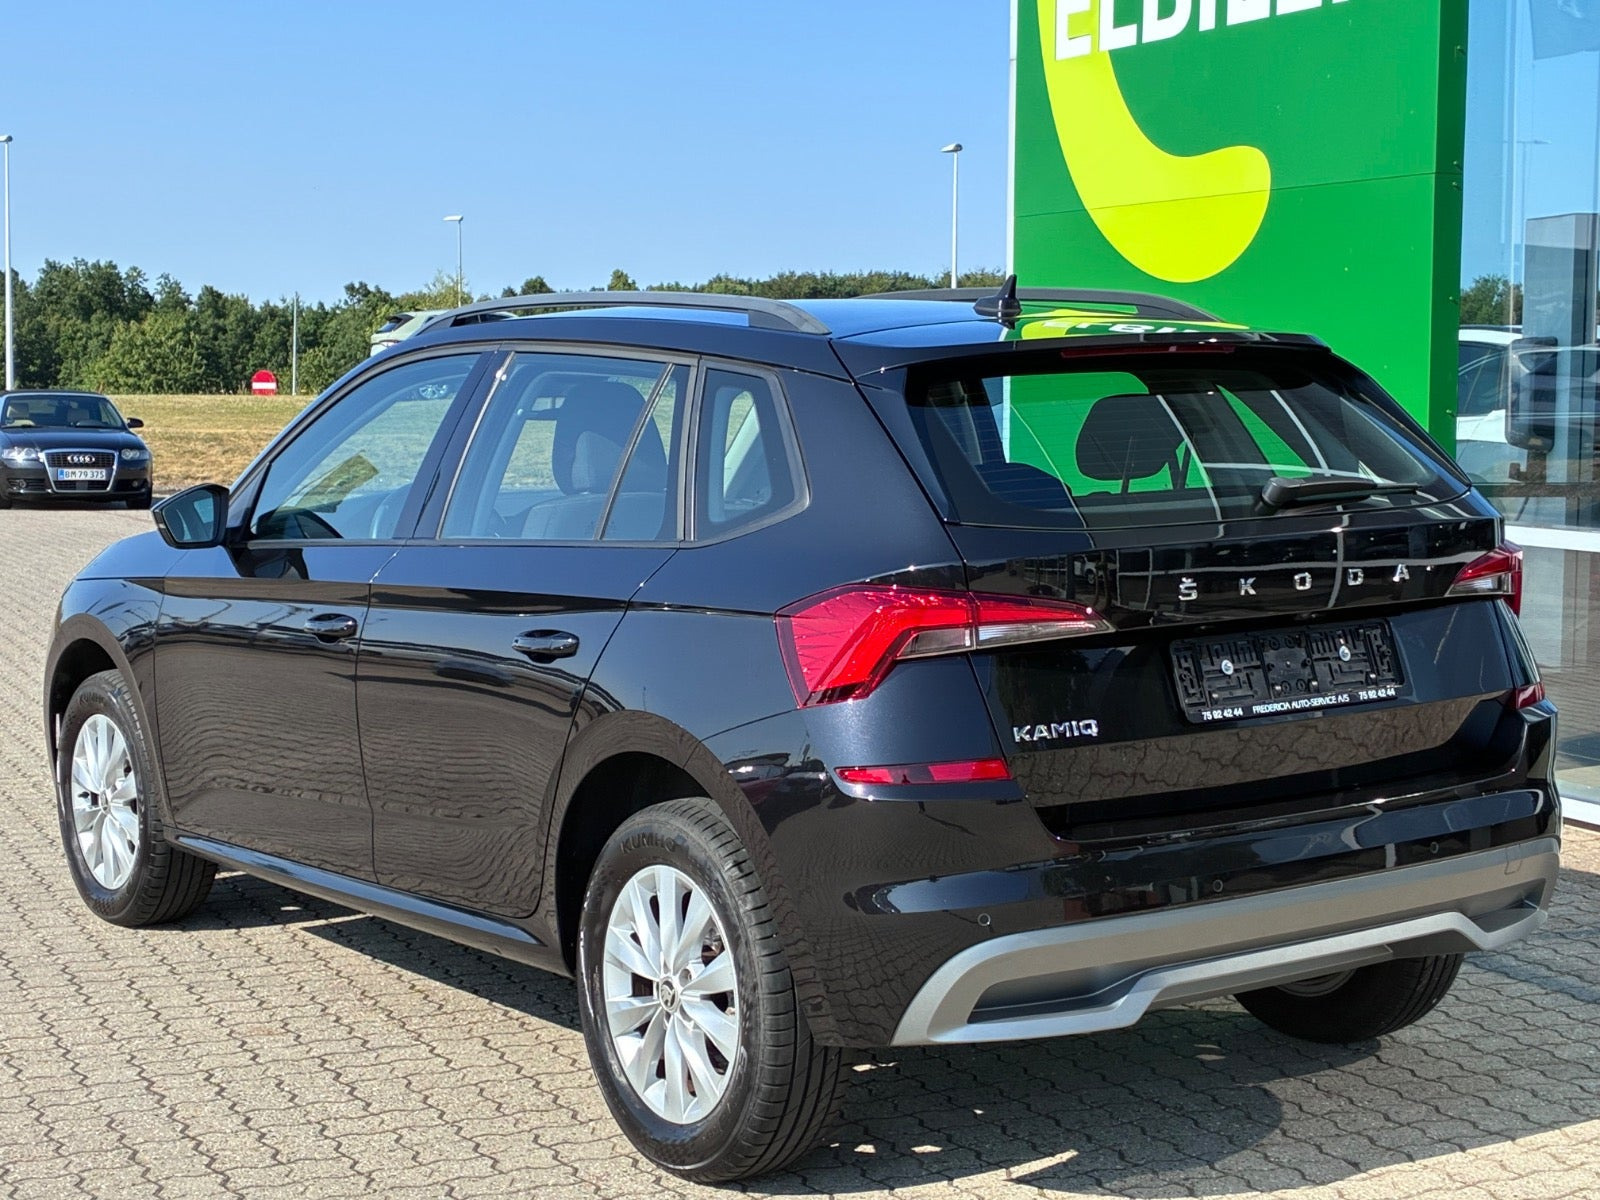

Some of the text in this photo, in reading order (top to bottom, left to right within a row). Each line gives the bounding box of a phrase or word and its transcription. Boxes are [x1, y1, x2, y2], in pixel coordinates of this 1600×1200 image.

[64, 470, 105, 478] BM 79 375
[1178, 563, 1411, 601] ŠKODA
[1202, 711, 1212, 720] 75
[1223, 708, 1233, 718] 42
[1233, 707, 1243, 717] 44
[1291, 695, 1337, 709] AUTO-SERVICE
[1358, 691, 1368, 700] 75
[1377, 688, 1387, 698] 42
[1386, 687, 1396, 697] 44
[1012, 718, 1099, 742] KAMIQ
